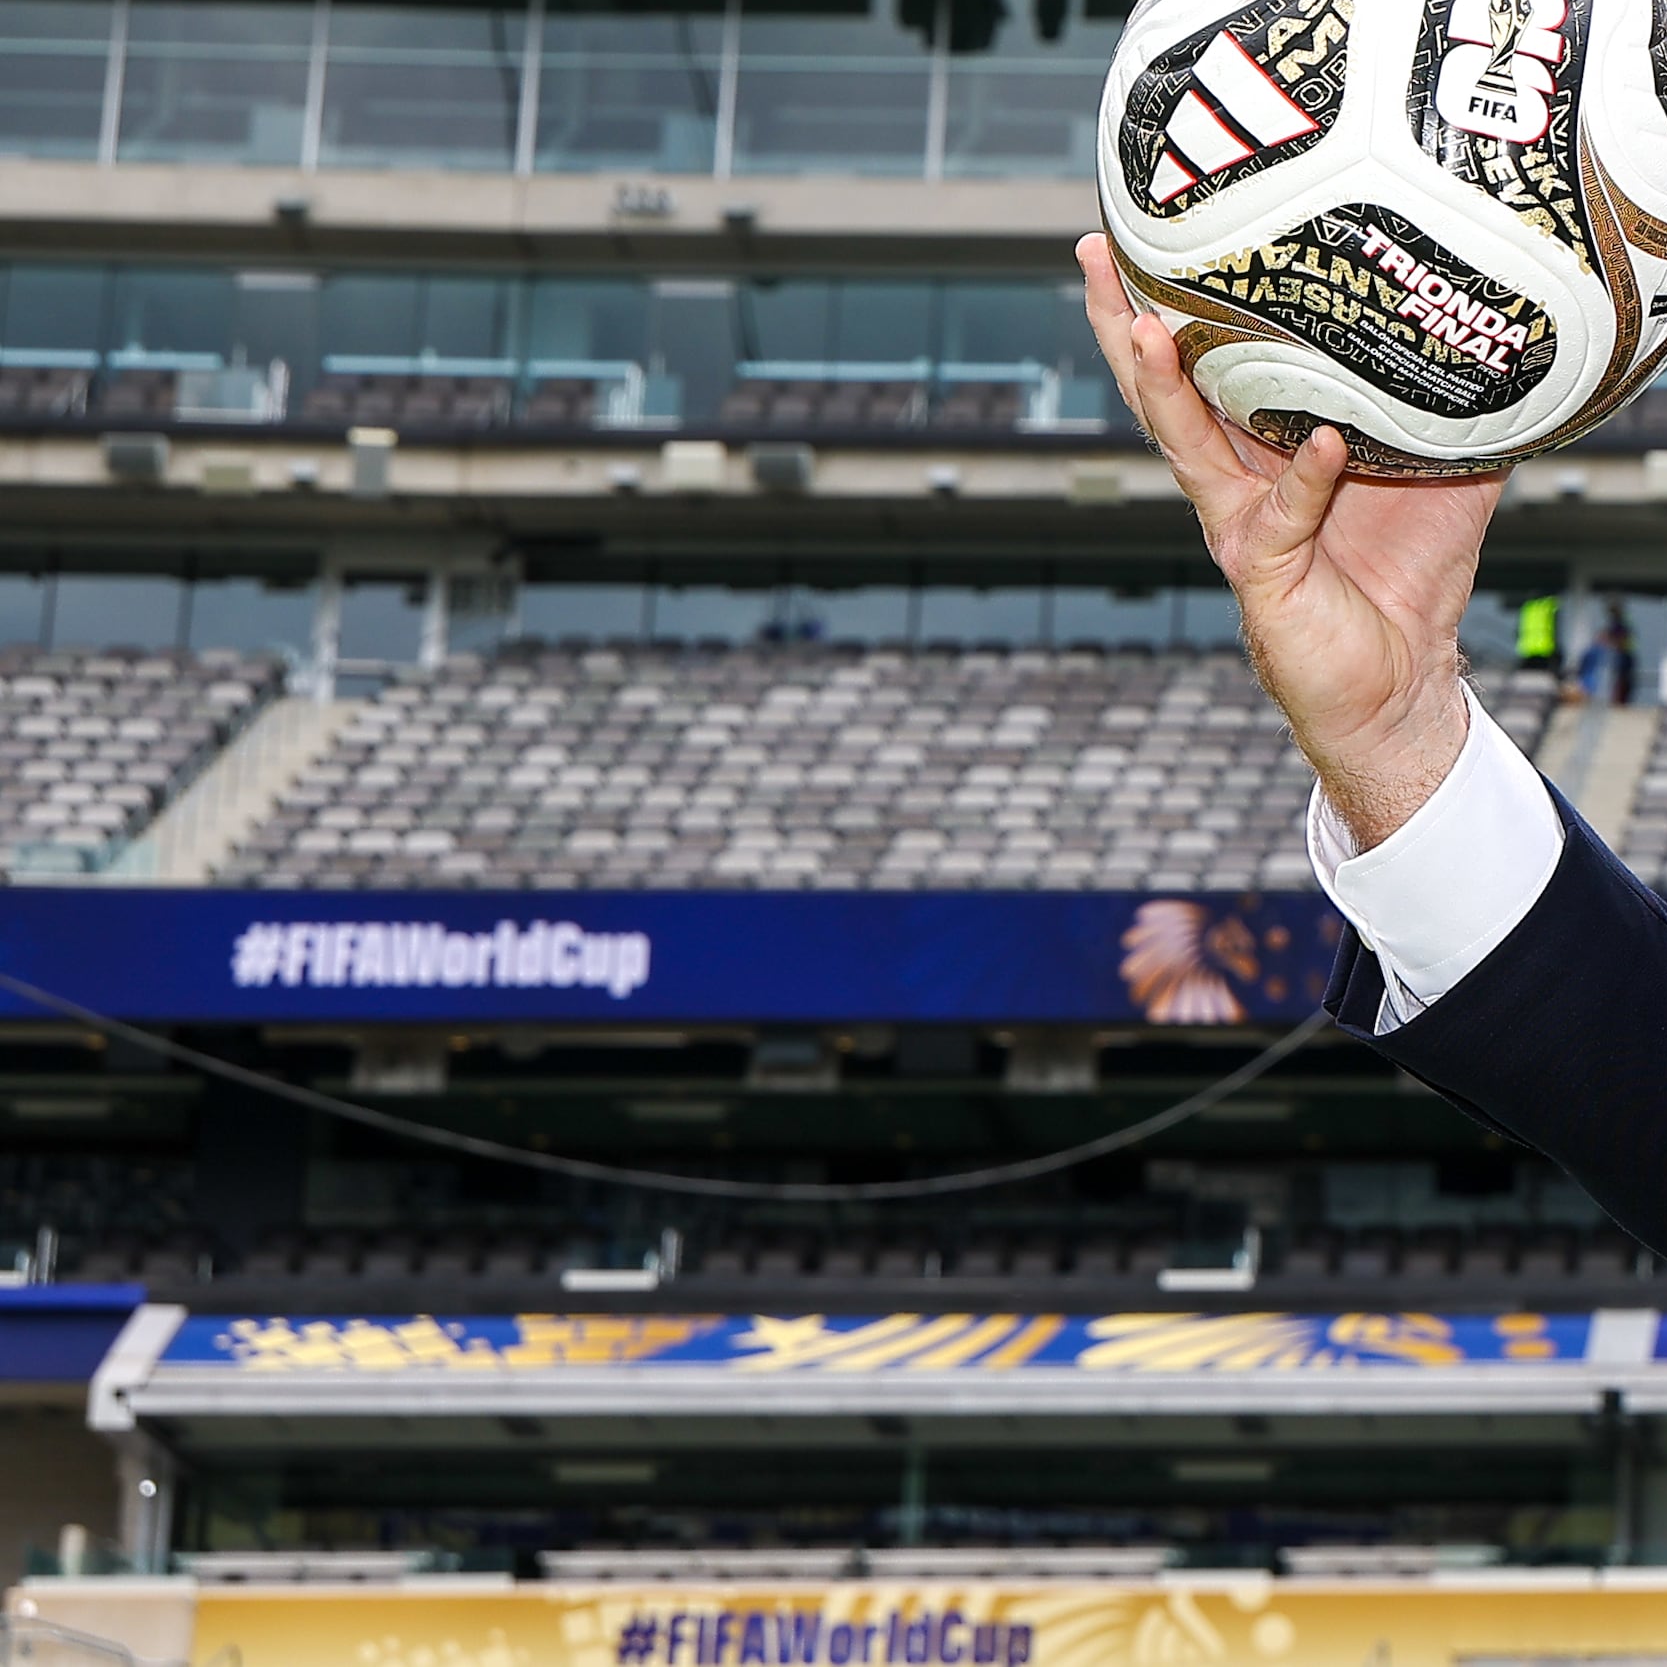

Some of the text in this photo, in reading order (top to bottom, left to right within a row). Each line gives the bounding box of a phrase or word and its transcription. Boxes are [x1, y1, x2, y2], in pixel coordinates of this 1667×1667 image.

[1468, 96, 1518, 124] FIFA
[1361, 222, 1529, 352] TRIONDA
[1396, 292, 1512, 374] FINAL
[1346, 332, 1471, 409] BALLON DE MATCH OFFICIEL
[1377, 342, 1478, 402] OFFICIAL MATCH BALL
[1391, 340, 1428, 369] OFICIAL
[1427, 363, 1447, 379] DEL
[1445, 370, 1486, 394] PARTIDO
[1476, 363, 1502, 380] PRO
[230, 918, 652, 999] #FIFAWorldCup
[615, 1607, 1034, 1667] #FIFAWorldCup
